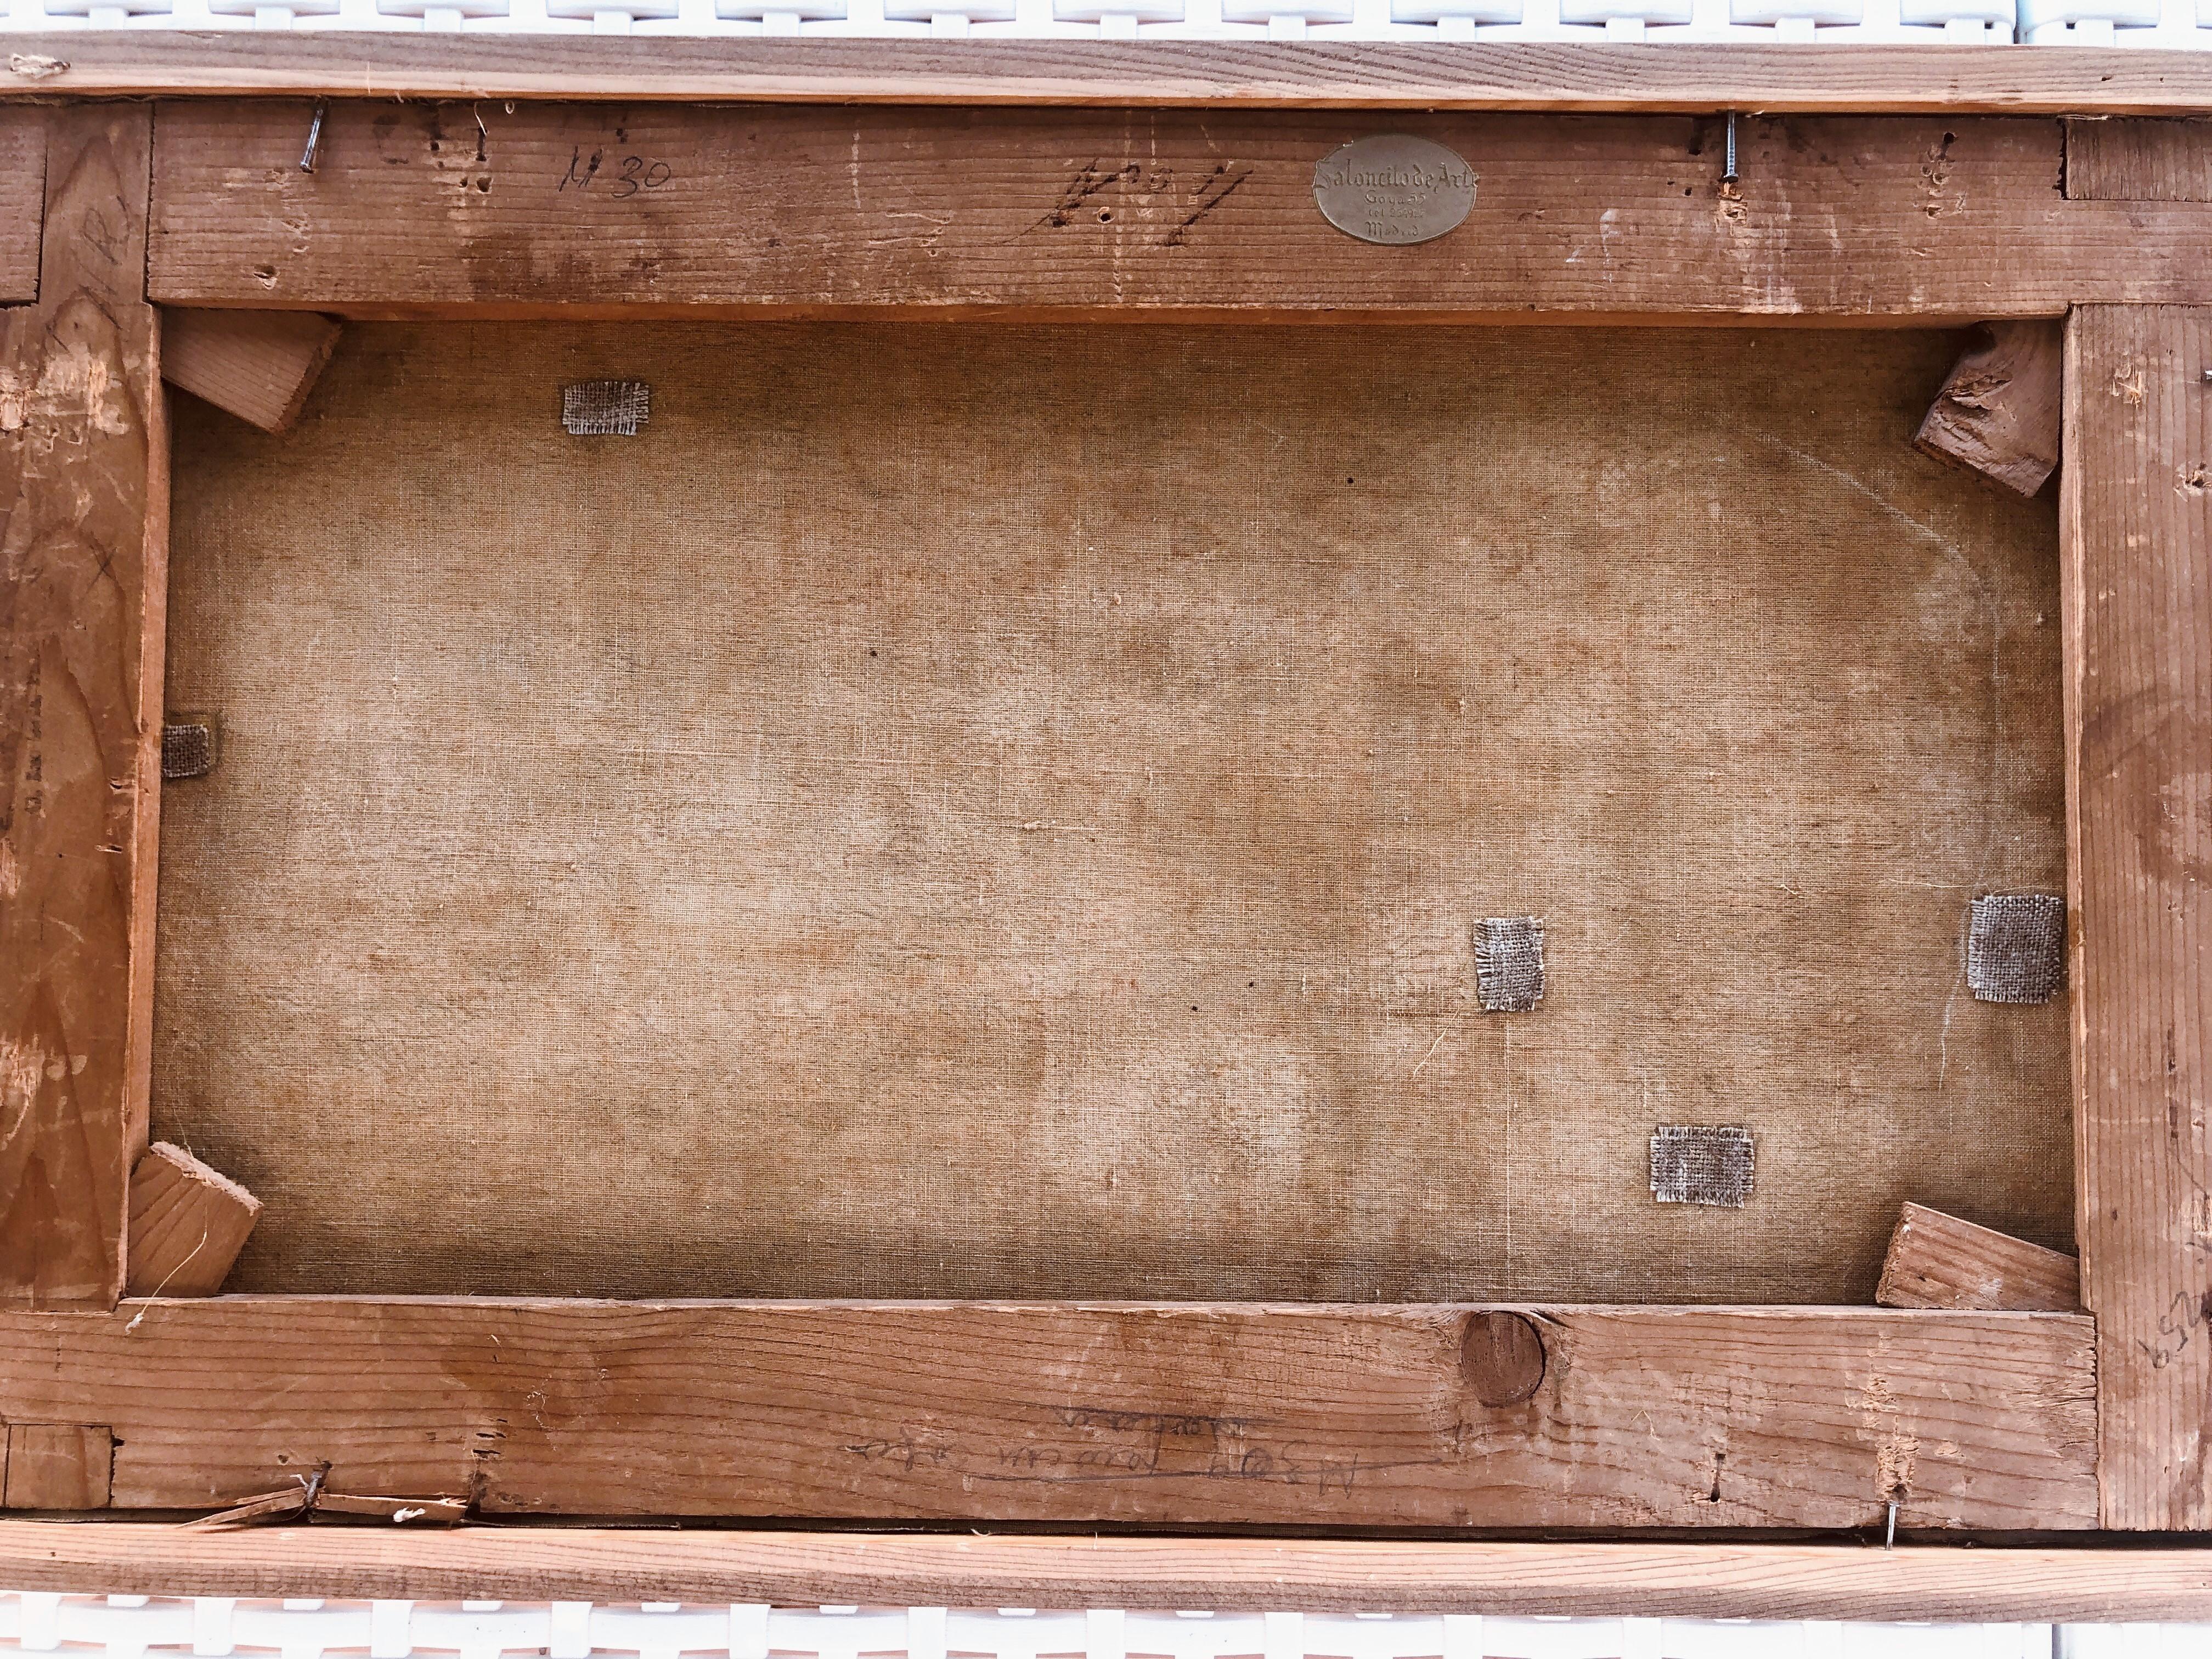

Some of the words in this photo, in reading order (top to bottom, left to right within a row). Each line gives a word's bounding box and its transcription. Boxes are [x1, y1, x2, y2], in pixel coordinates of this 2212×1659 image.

[612, 155, 672, 198] 30
[1412, 163, 1435, 189] de
[1364, 189, 1404, 206] Goya
